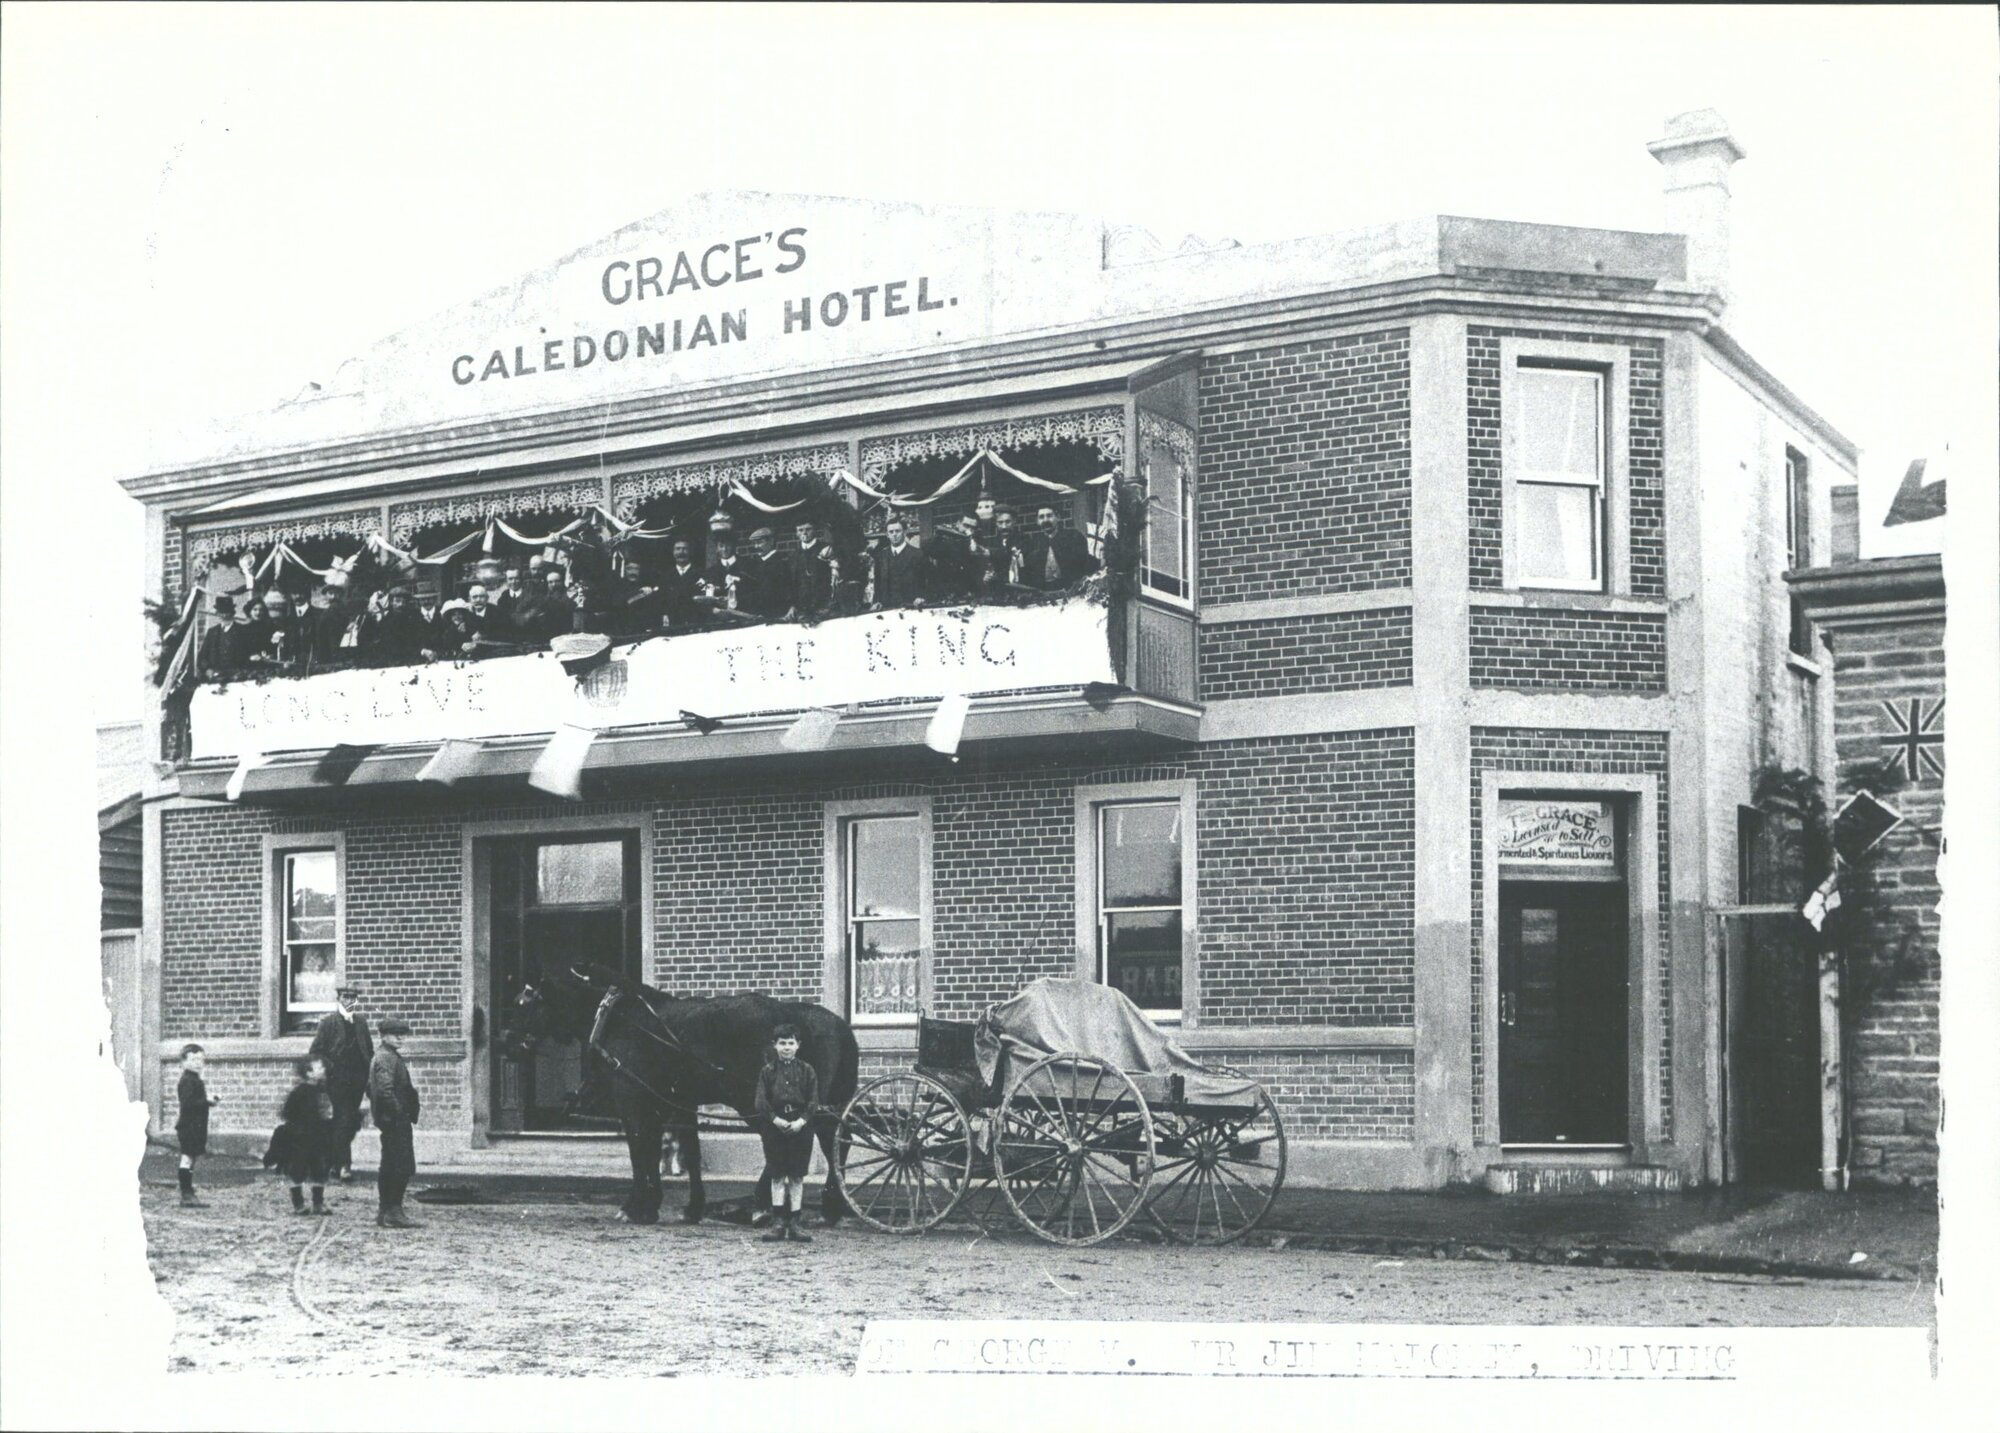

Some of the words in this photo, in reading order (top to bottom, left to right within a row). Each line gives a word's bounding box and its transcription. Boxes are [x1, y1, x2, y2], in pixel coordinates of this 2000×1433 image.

[602, 227, 807, 305] GRACE'S
[452, 308, 747, 385] CALEDONIAN
[783, 277, 958, 334] HOTEL.
[240, 690, 349, 729] LONG
[373, 672, 485, 719] LIVE
[717, 640, 815, 682] THE
[865, 624, 1015, 673] KING
[1121, 965, 1182, 997] BAR
